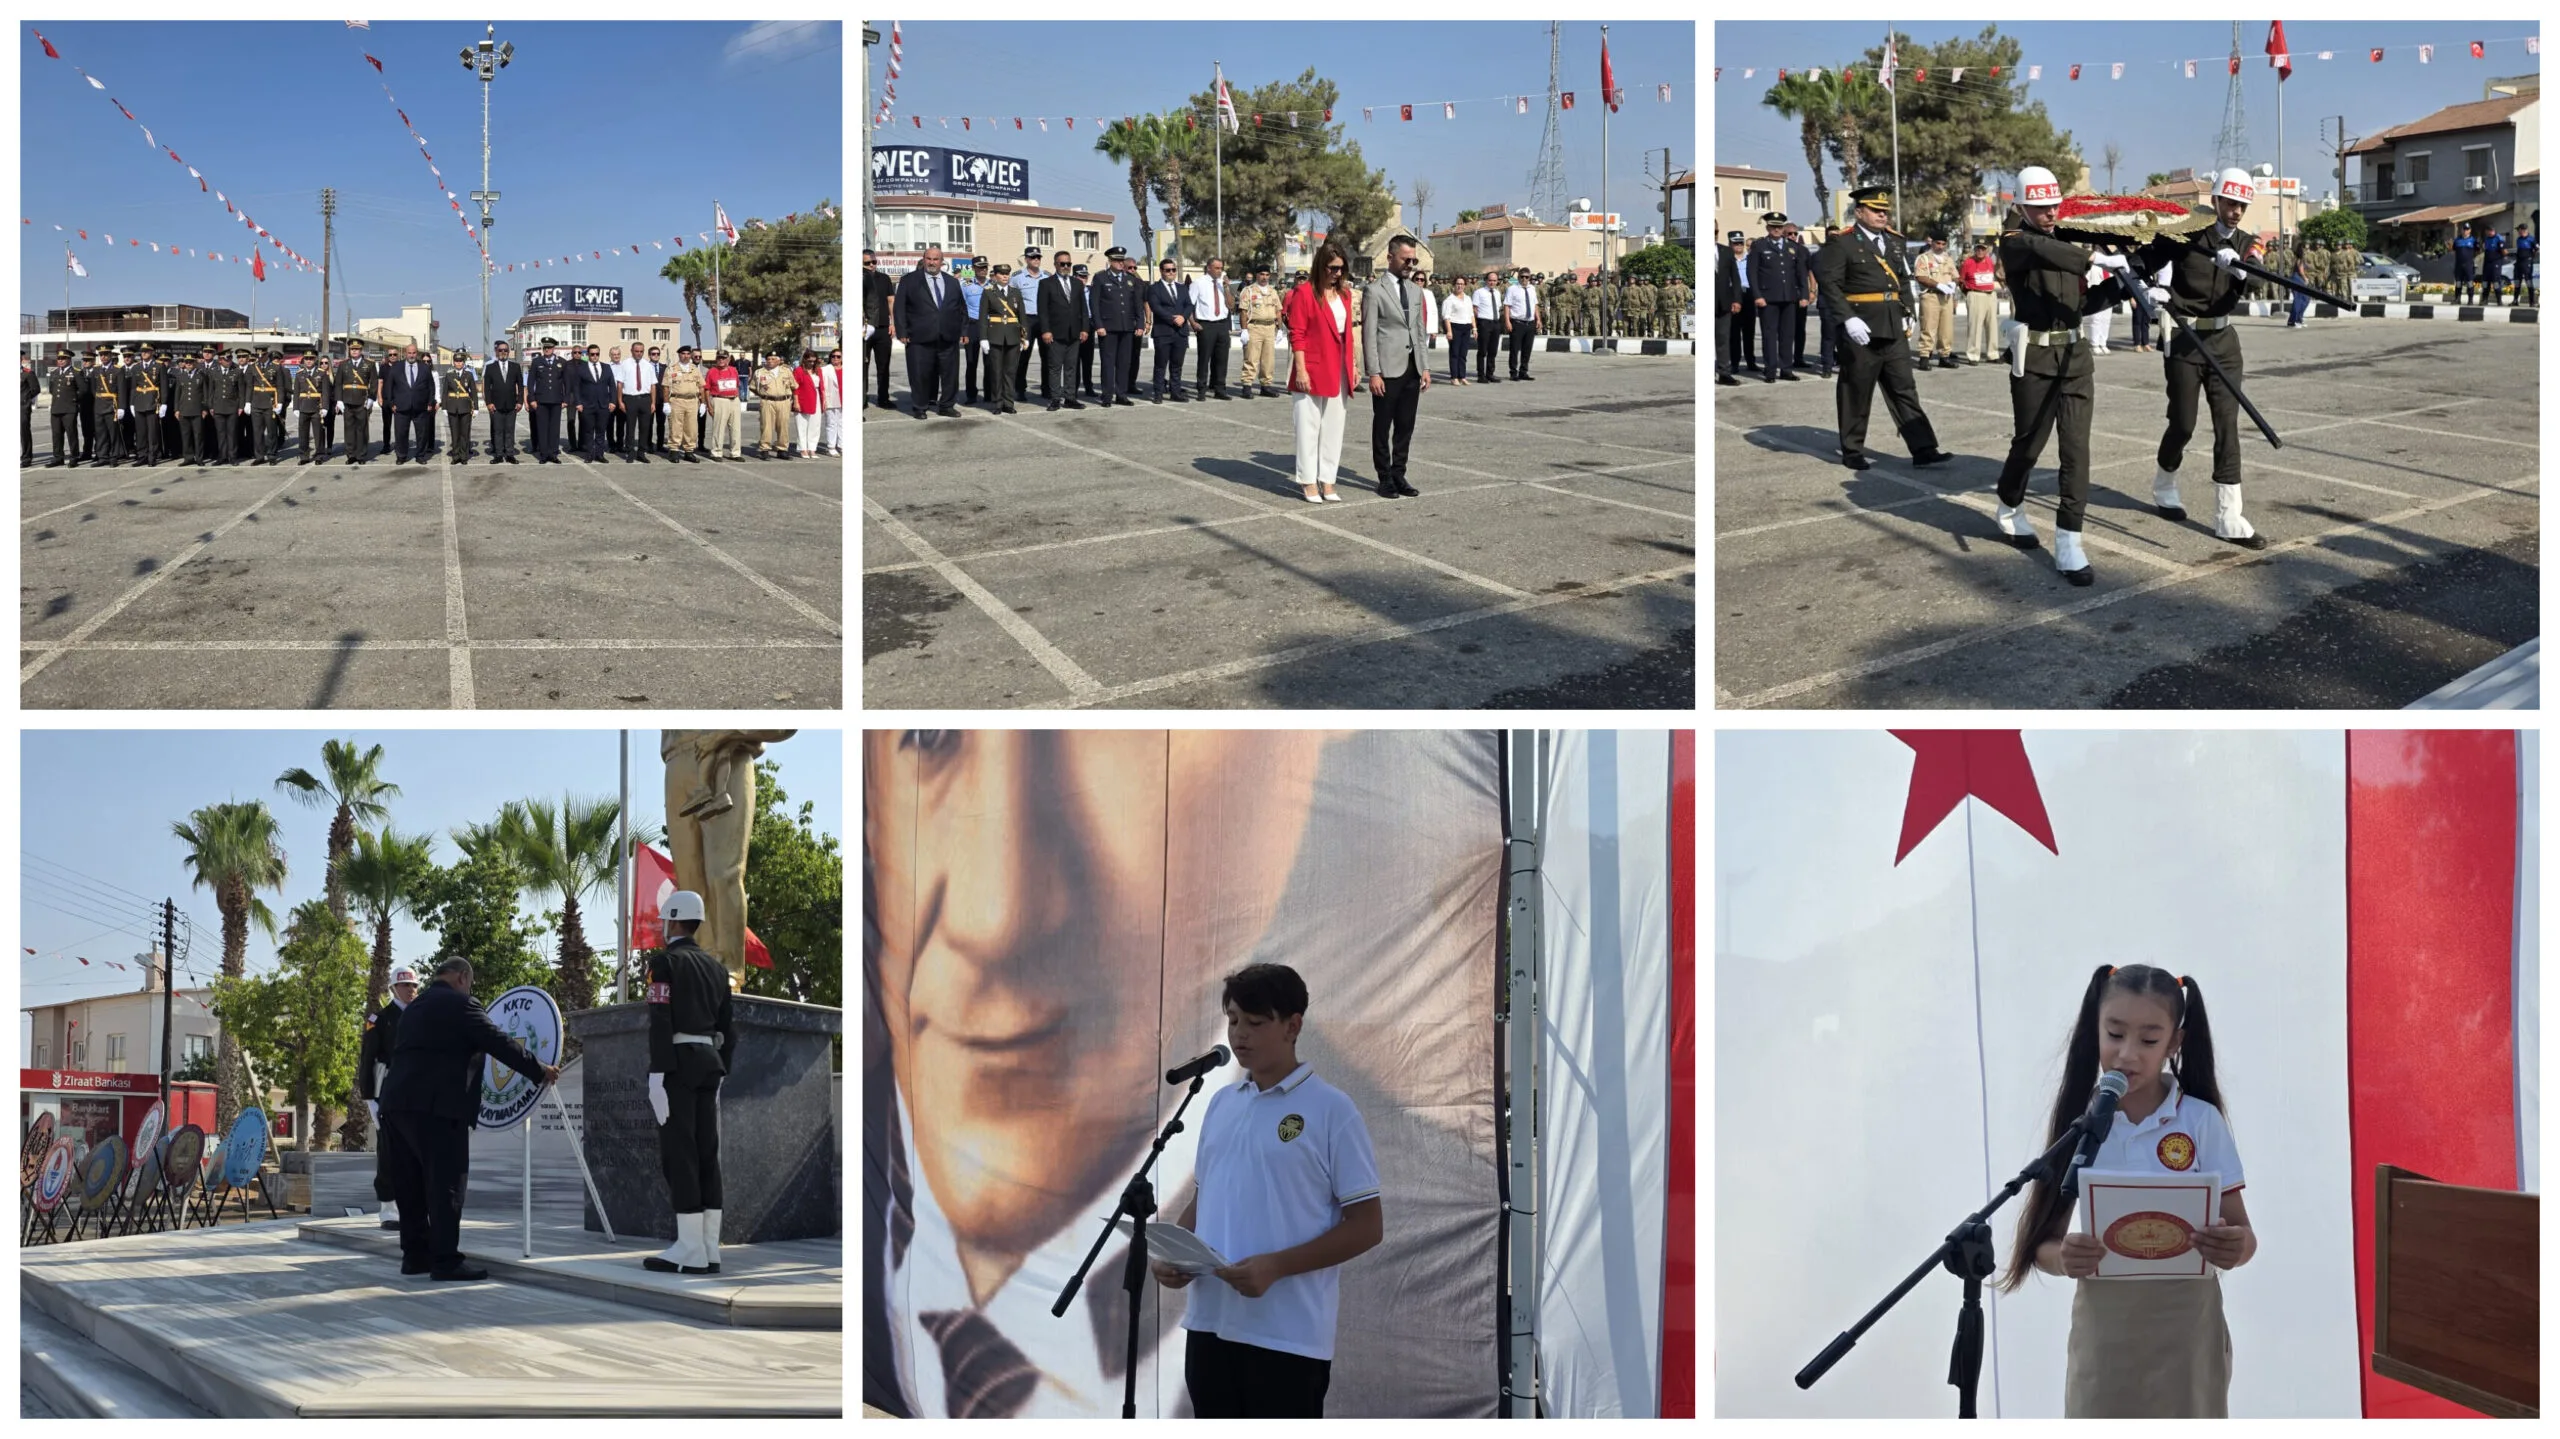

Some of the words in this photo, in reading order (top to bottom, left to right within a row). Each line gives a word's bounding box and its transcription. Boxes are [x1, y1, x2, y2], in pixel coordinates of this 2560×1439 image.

[503, 998, 533, 1014] KKTC
[64, 1075, 93, 1087] Ziraat
[94, 1076, 131, 1089] Bankası
[478, 1082, 539, 1121] KAYMAKAML
